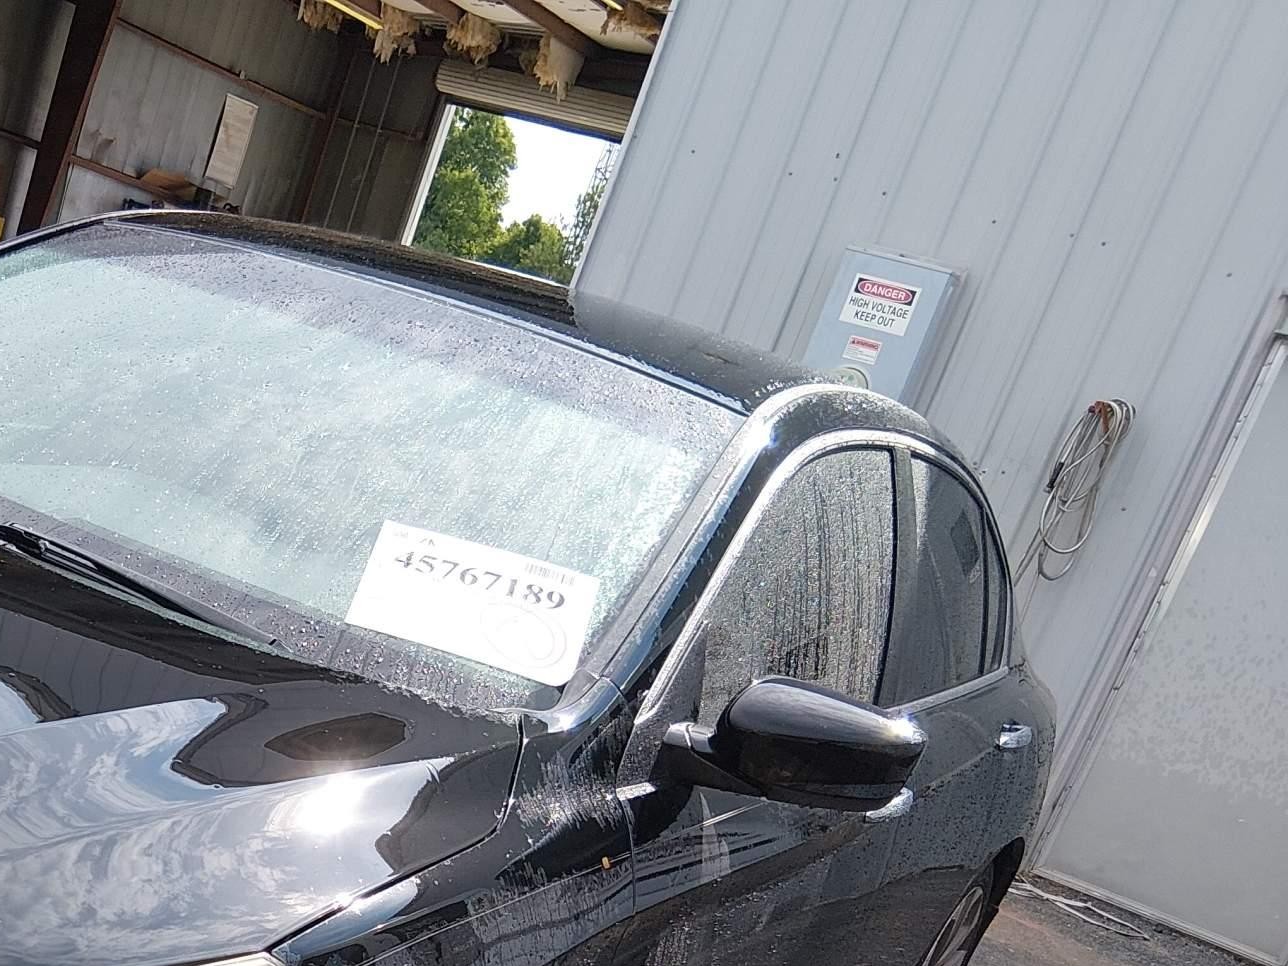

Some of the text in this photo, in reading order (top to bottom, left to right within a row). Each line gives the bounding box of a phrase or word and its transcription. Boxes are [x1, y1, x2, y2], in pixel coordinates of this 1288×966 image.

[863, 282, 906, 301] DANGER
[849, 296, 910, 320] HIGH VOLTAGE
[853, 309, 896, 329] KEEP OUT
[394, 551, 566, 609] 45767189
